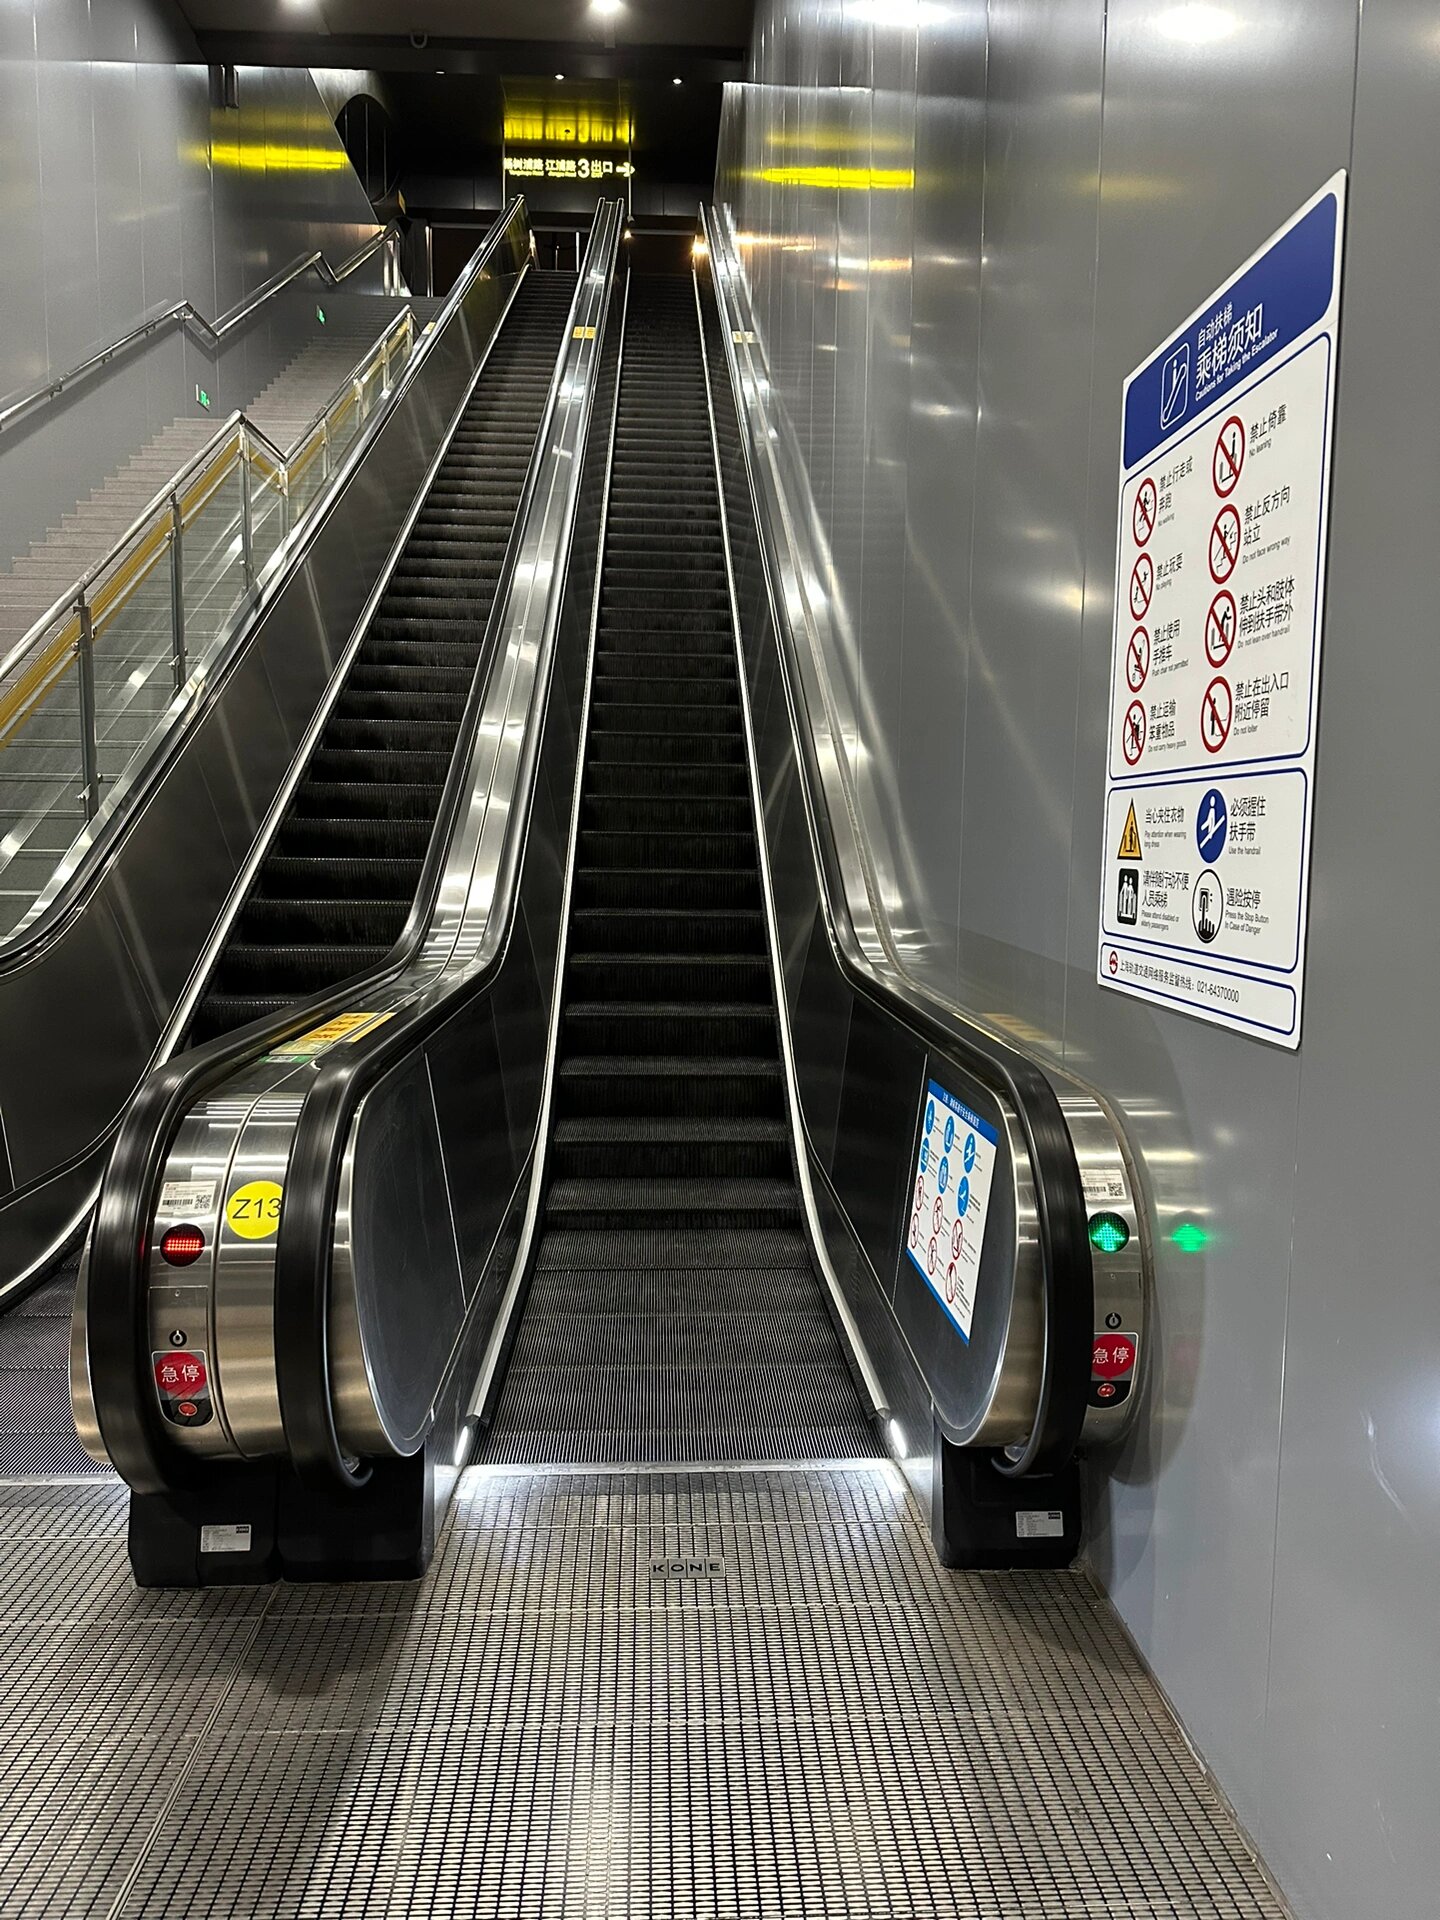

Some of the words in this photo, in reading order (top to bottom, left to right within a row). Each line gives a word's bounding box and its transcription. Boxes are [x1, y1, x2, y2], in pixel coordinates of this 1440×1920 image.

[1198, 301, 1232, 350] 自动扶梯
[1196, 303, 1262, 388] 乘梯须知
[1196, 380, 1216, 401] Cautions
[1225, 359, 1241, 377] Taking
[1242, 352, 1250, 364] the
[1252, 329, 1278, 356] Escalator
[1250, 404, 1287, 443] 禁止倚靠
[1245, 485, 1290, 525] 禁止反方向
[1244, 523, 1260, 546] 站立
[1240, 575, 1295, 615] 禁止头和肢体
[1239, 599, 1293, 637] 伸到扶手带外
[1153, 619, 1180, 645] 禁止使用
[1153, 645, 1172, 666] 手推车
[1235, 672, 1288, 701] 禁止在出入口
[1234, 698, 1269, 722] 附近停留
[1145, 806, 1184, 823] 当心夹住衣物
[1230, 796, 1266, 817] 必须握住
[1229, 822, 1256, 841] 扶手带
[1226, 888, 1261, 909] 遇险按停
[232, 1198, 282, 1219] Z13
[1092, 1347, 1129, 1364] 急停
[161, 1365, 200, 1383] 急停
[653, 1563, 720, 1572] KONE
